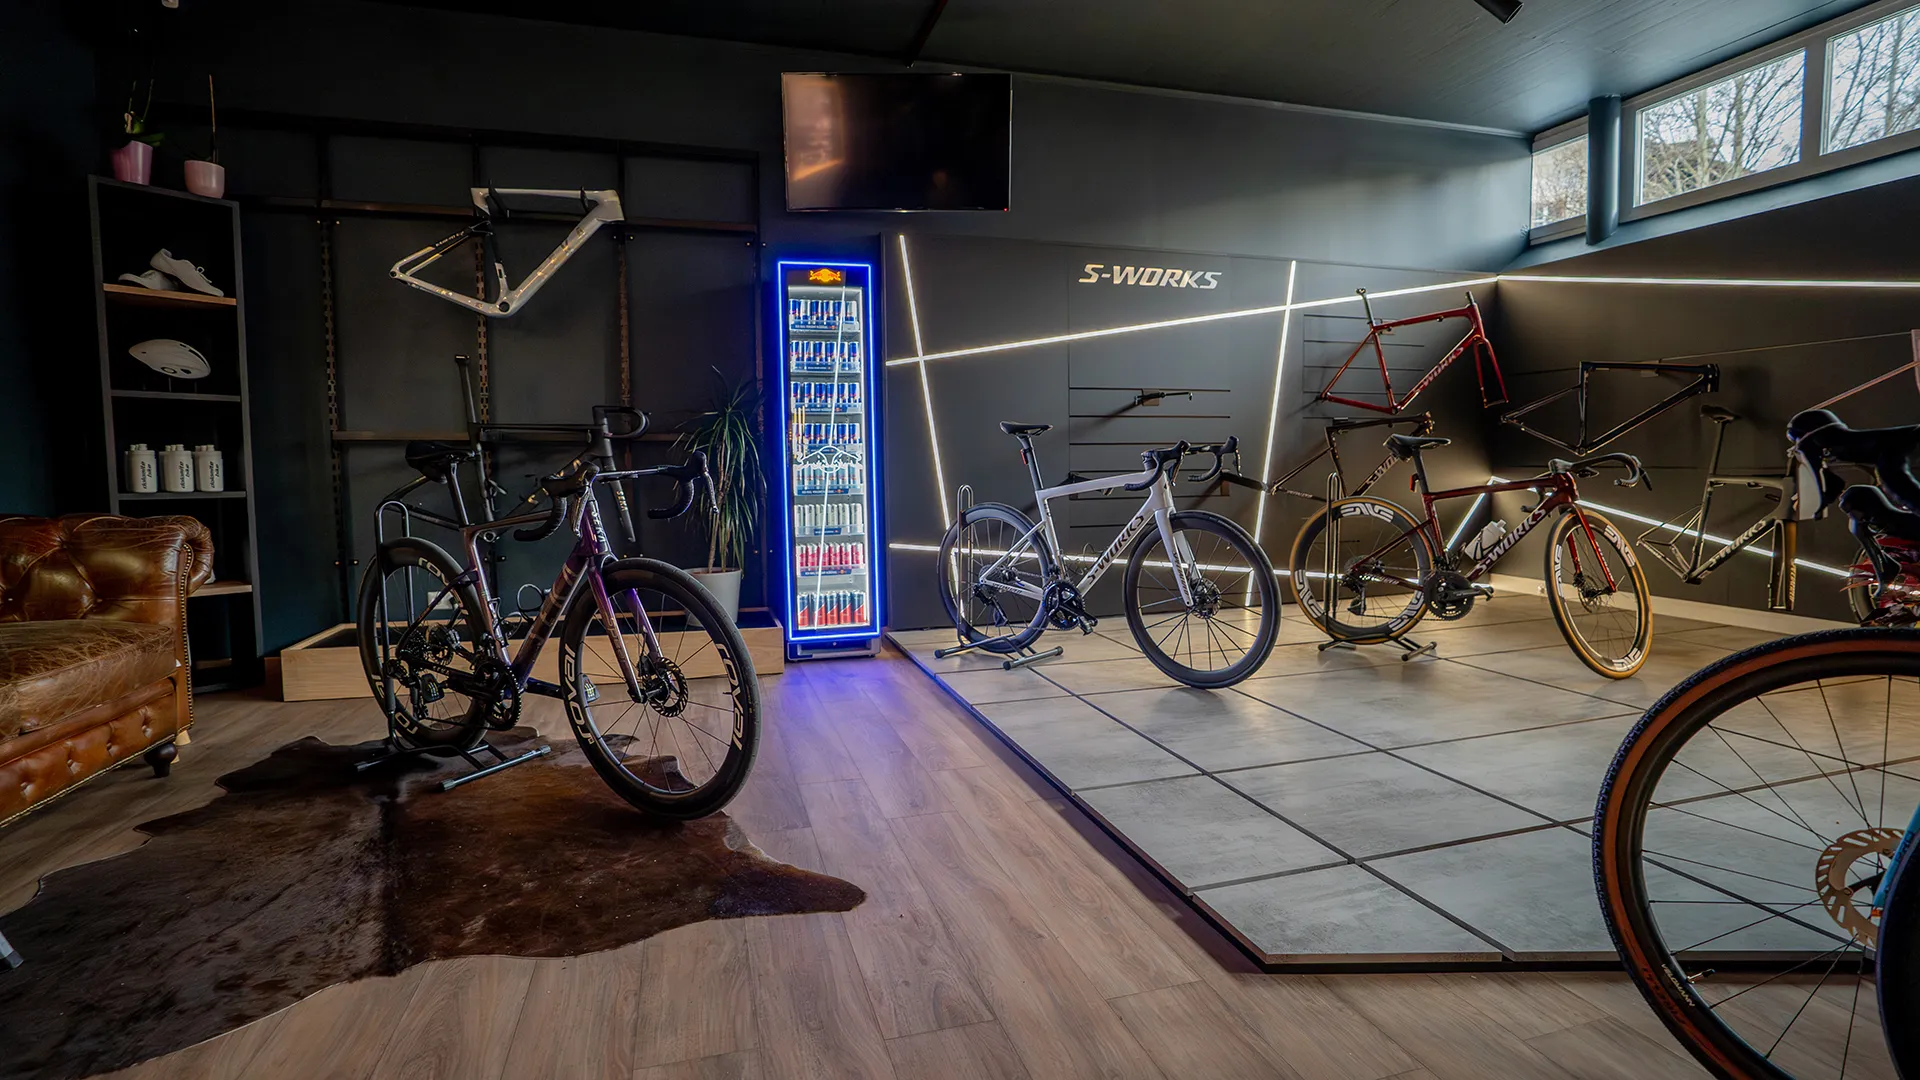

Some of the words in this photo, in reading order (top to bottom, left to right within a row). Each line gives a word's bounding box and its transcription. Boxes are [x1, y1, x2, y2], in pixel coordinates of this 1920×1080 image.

[1078, 263, 1222, 290] S-WORKS
[1087, 515, 1144, 585] S-WORKS
[1478, 508, 1547, 576] S-WORKS
[1707, 519, 1768, 568] S-WORKS
[1661, 963, 1695, 1007] VELOMANN
